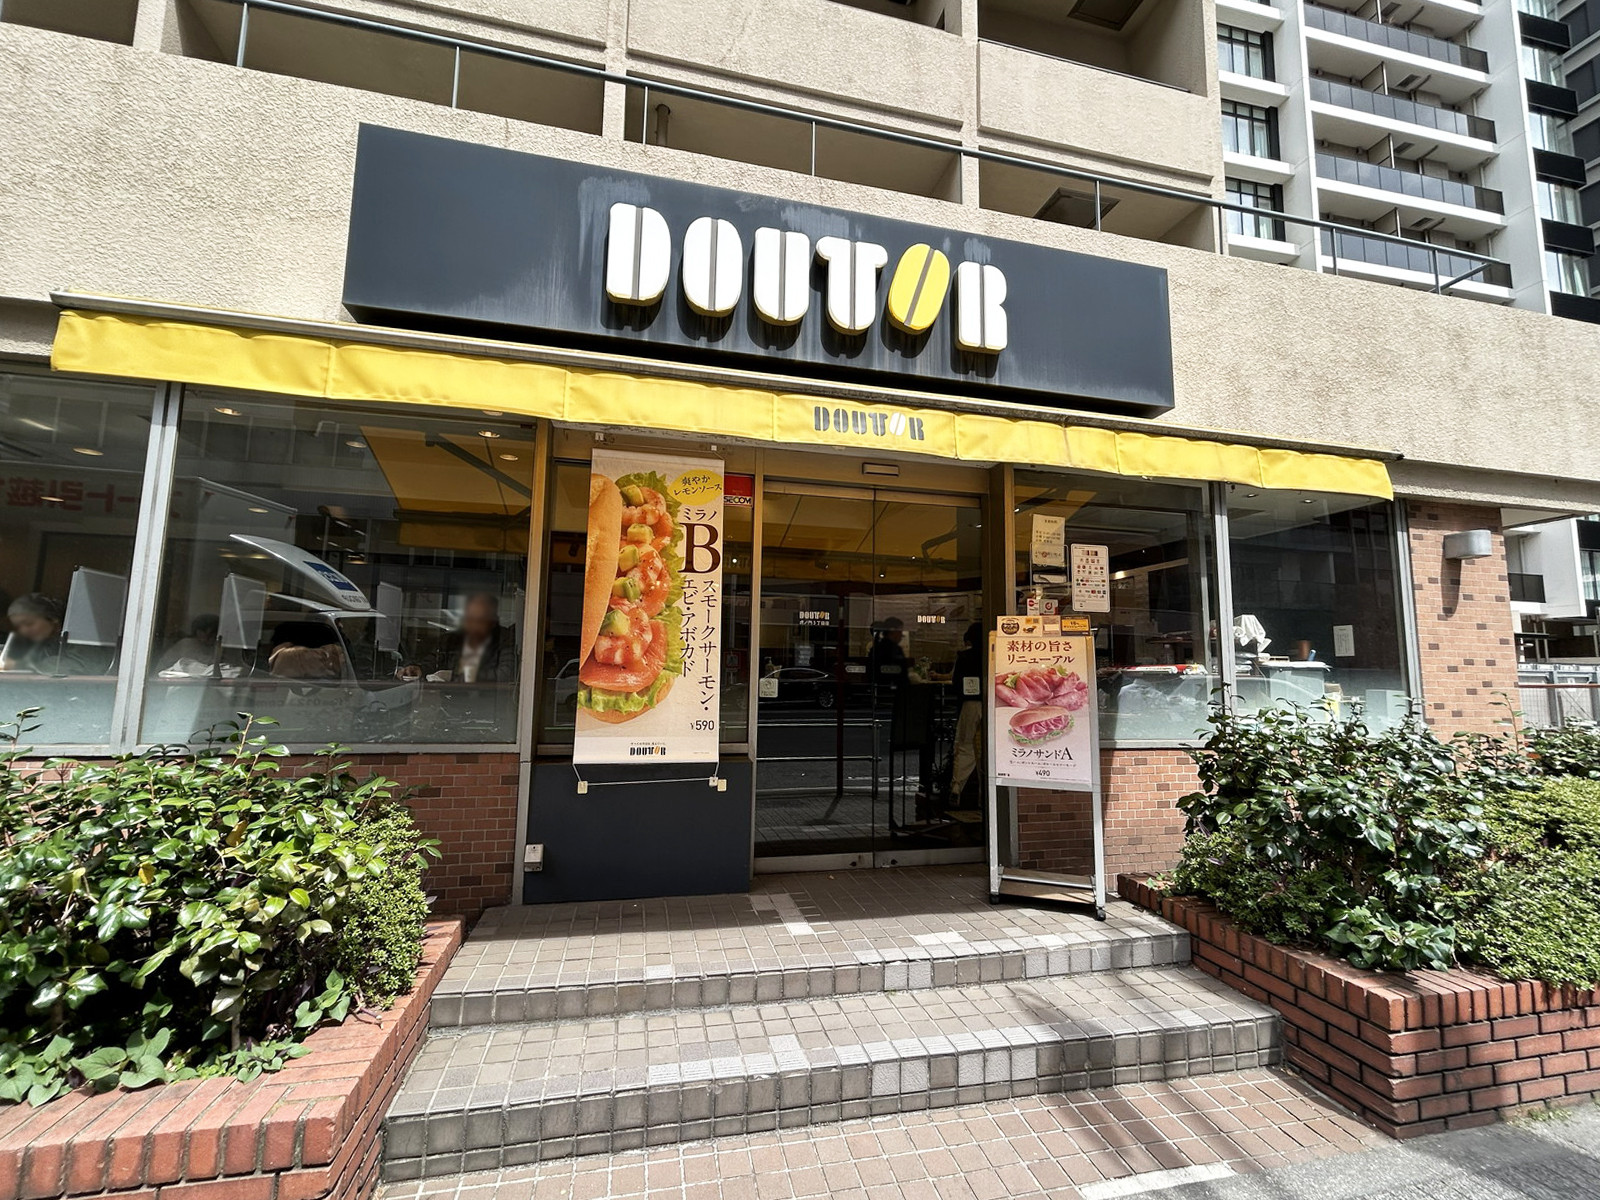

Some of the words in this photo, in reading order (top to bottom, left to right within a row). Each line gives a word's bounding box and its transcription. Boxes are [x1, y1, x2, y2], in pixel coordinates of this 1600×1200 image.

[605, 202, 1008, 355] DOUTOR
[814, 406, 925, 441] DOUTOR
[682, 474, 711, 487] 爽やか
[673, 483, 723, 496] レモンソース
[724, 495, 752, 505] SECOM
[682, 508, 718, 522] ミラノ
[678, 522, 722, 574] B
[799, 610, 830, 621] DOUTOR
[917, 615, 946, 624] DOUTOR
[1007, 640, 1073, 653] 素材の旨さ
[1007, 654, 1075, 665] リニューアル
[690, 720, 715, 731] ¥590
[629, 745, 667, 756] DOUTOR
[1011, 746, 1074, 761] ミラノサンドA
